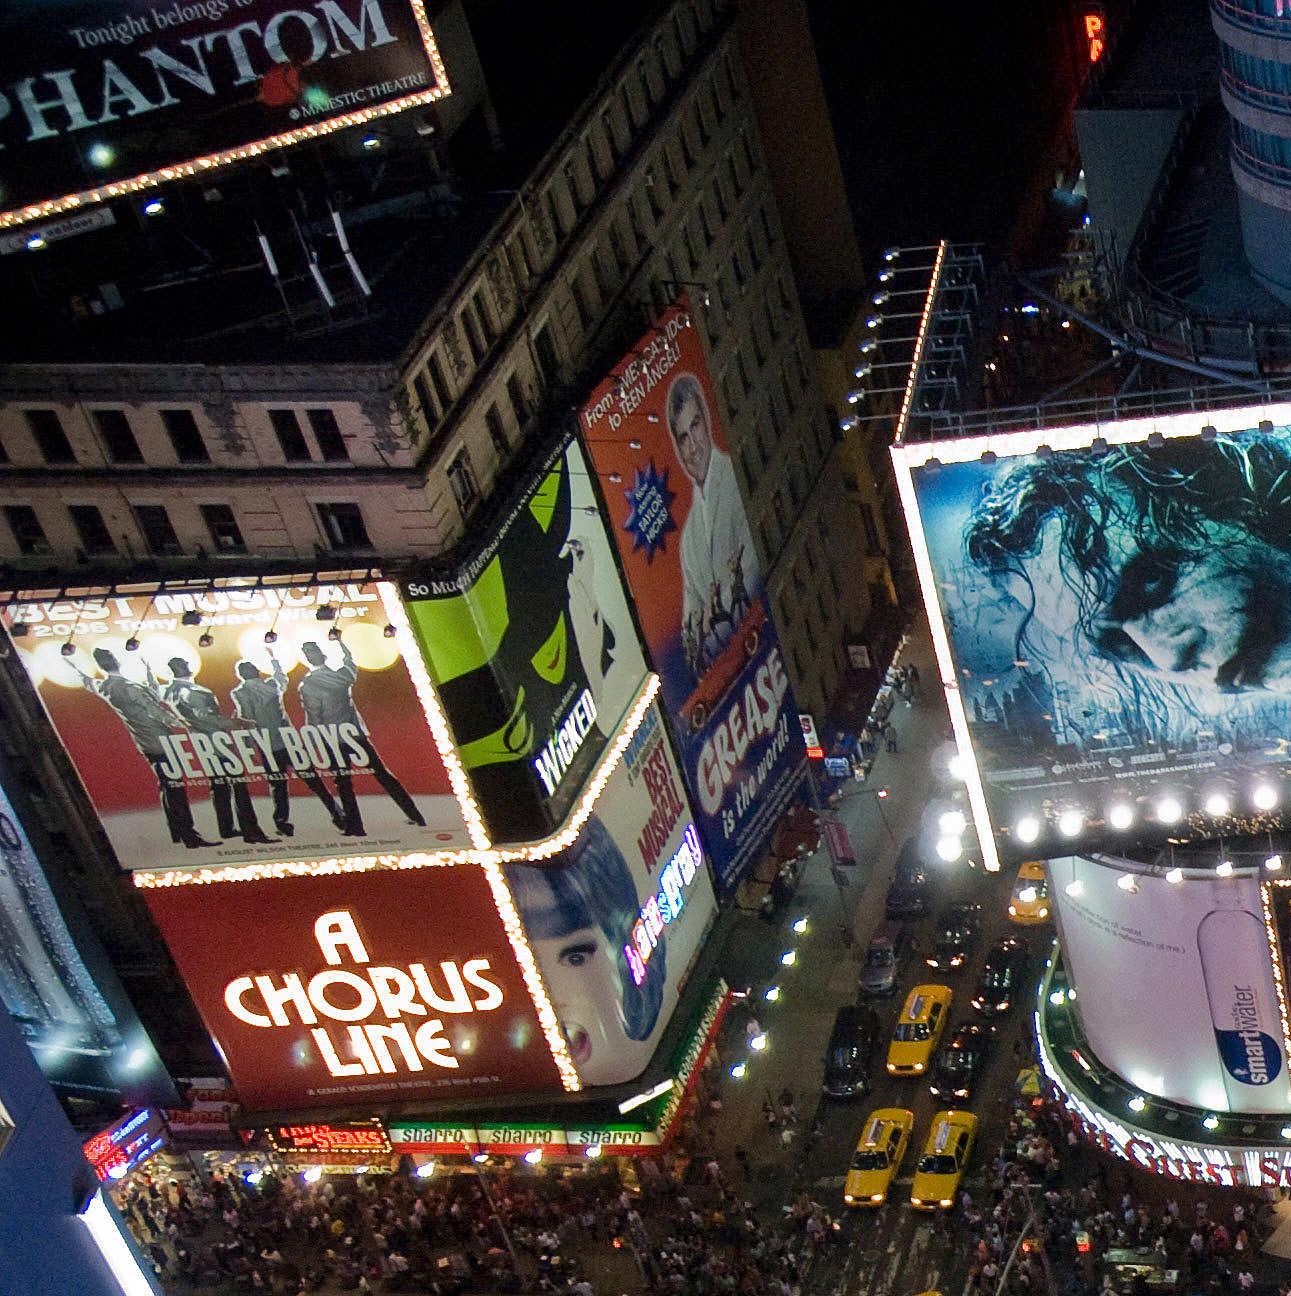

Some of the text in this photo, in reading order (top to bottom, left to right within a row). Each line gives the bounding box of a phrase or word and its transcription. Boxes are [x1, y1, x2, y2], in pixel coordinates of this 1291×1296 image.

[69, 14, 150, 49] Tonight
[0, 0, 399, 150] HANTOM
[154, 583, 377, 615] MUSICAL
[159, 727, 280, 780] JERSEY
[279, 722, 370, 771] BOYS
[696, 648, 788, 816] GREASE
[314, 909, 370, 965] A
[224, 958, 504, 1029] CHORUS
[310, 1017, 460, 1078] LINE
[1234, 984, 1269, 1084] smartwater
[402, 1127, 463, 1143] sbarro
[491, 1127, 553, 1144] sbarro
[579, 1129, 643, 1145] sbarro
